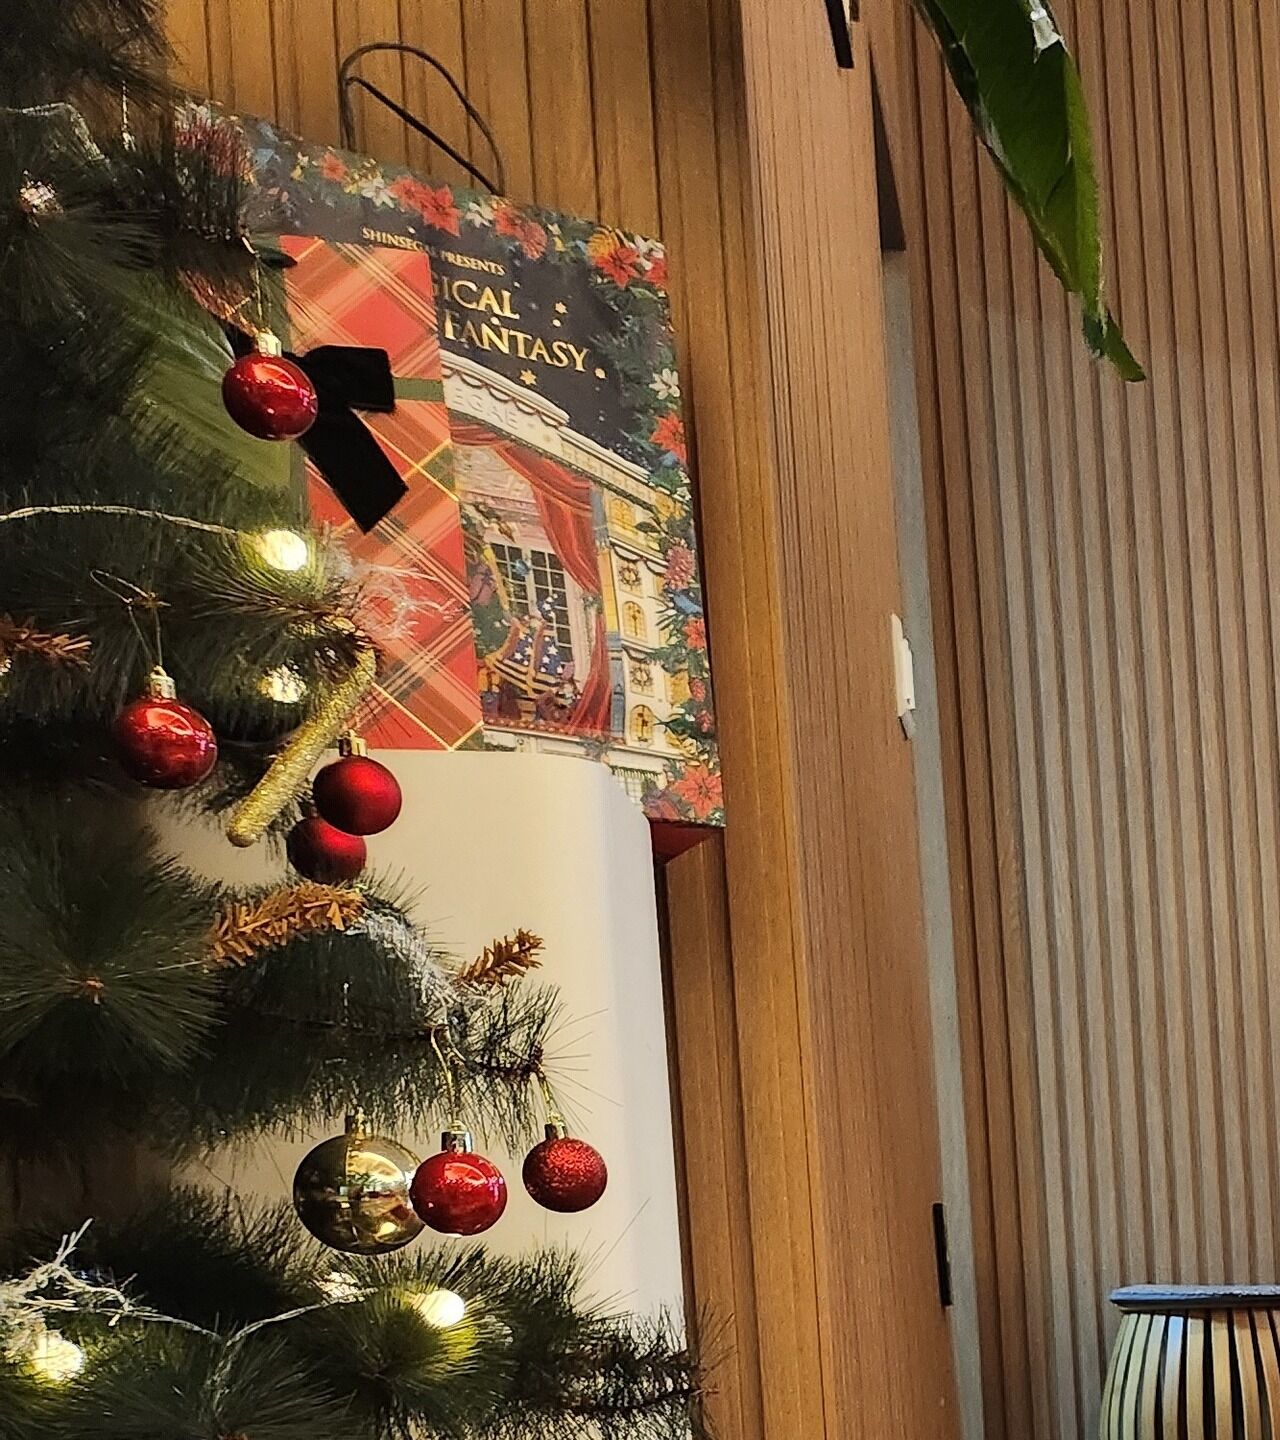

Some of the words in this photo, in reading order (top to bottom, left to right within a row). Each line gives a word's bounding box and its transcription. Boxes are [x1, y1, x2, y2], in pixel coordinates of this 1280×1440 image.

[441, 250, 506, 276] PRESENTS
[434, 272, 520, 320] ICAL
[442, 309, 590, 373] FANTASY
